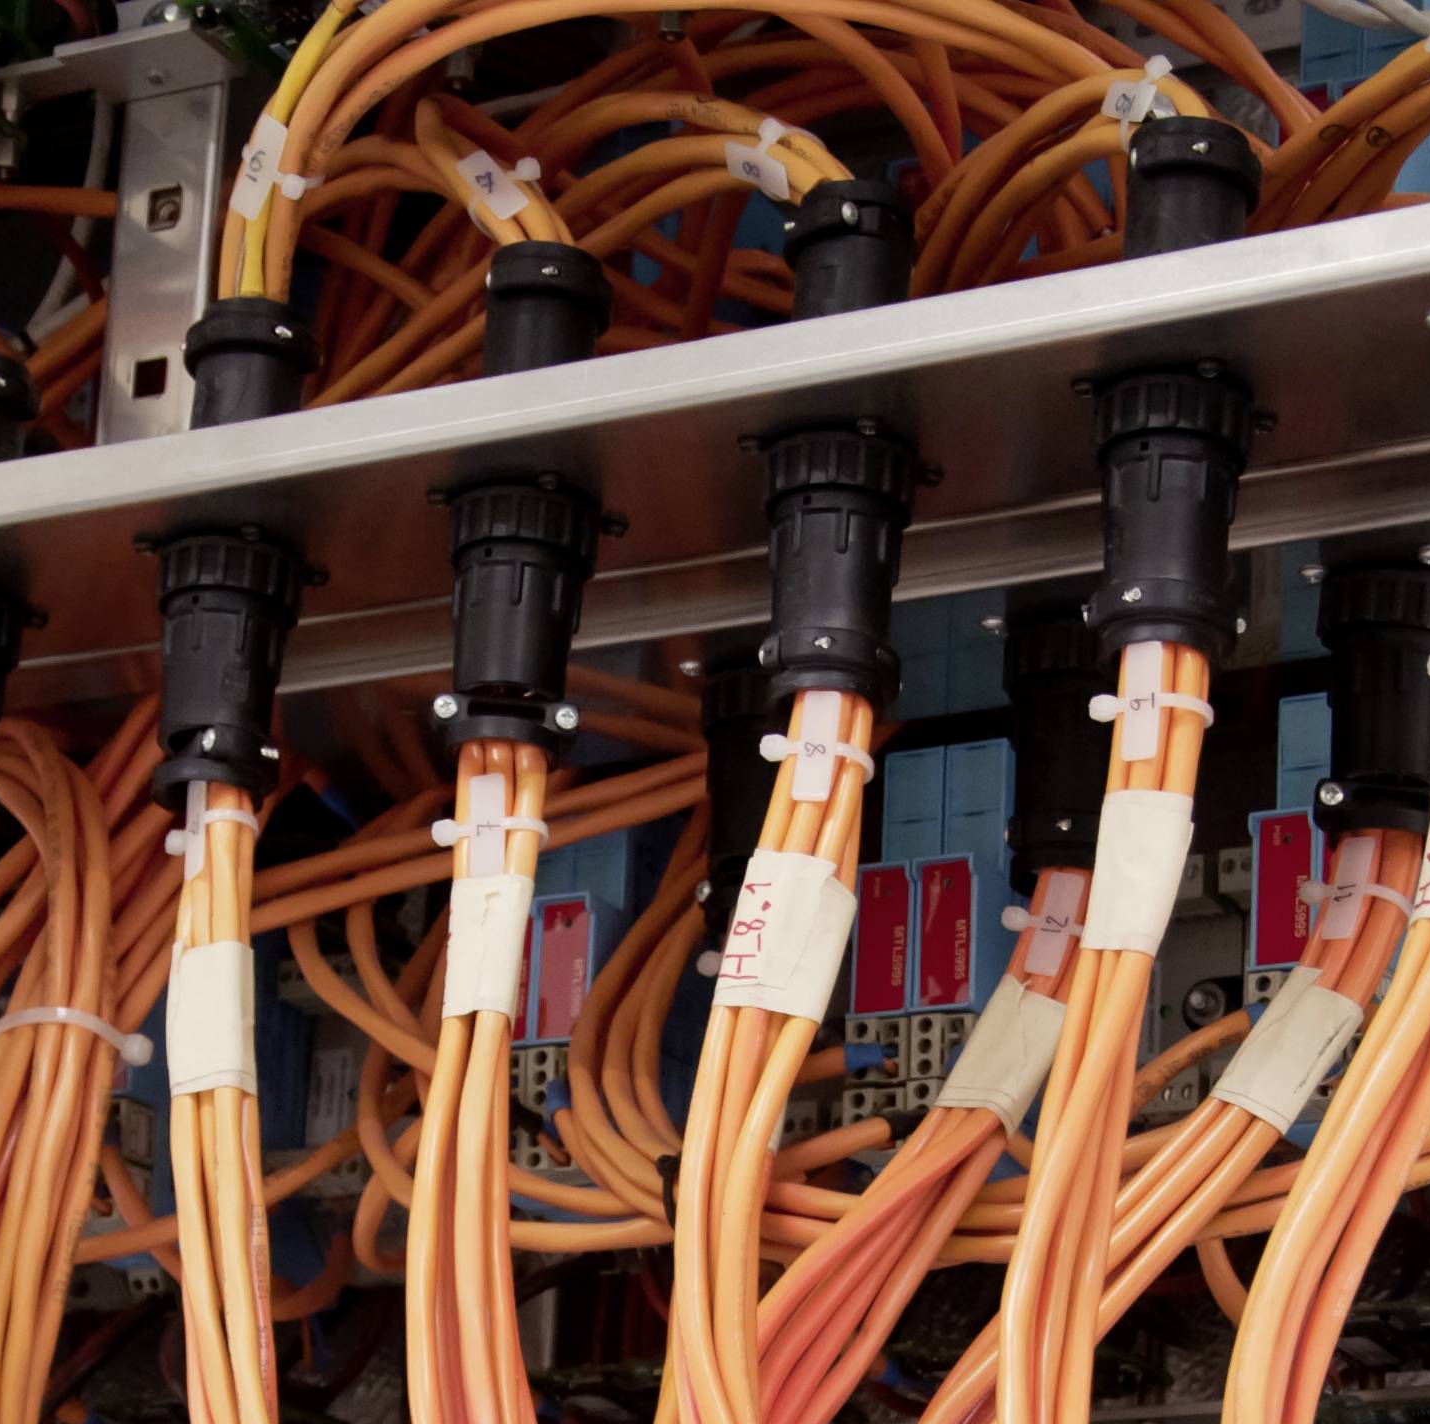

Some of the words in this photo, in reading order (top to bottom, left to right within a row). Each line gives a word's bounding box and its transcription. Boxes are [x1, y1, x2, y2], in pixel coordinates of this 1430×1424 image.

[803, 740, 828, 758] 8
[890, 924, 905, 988] MTL5995
[953, 918, 968, 981] MTL5995
